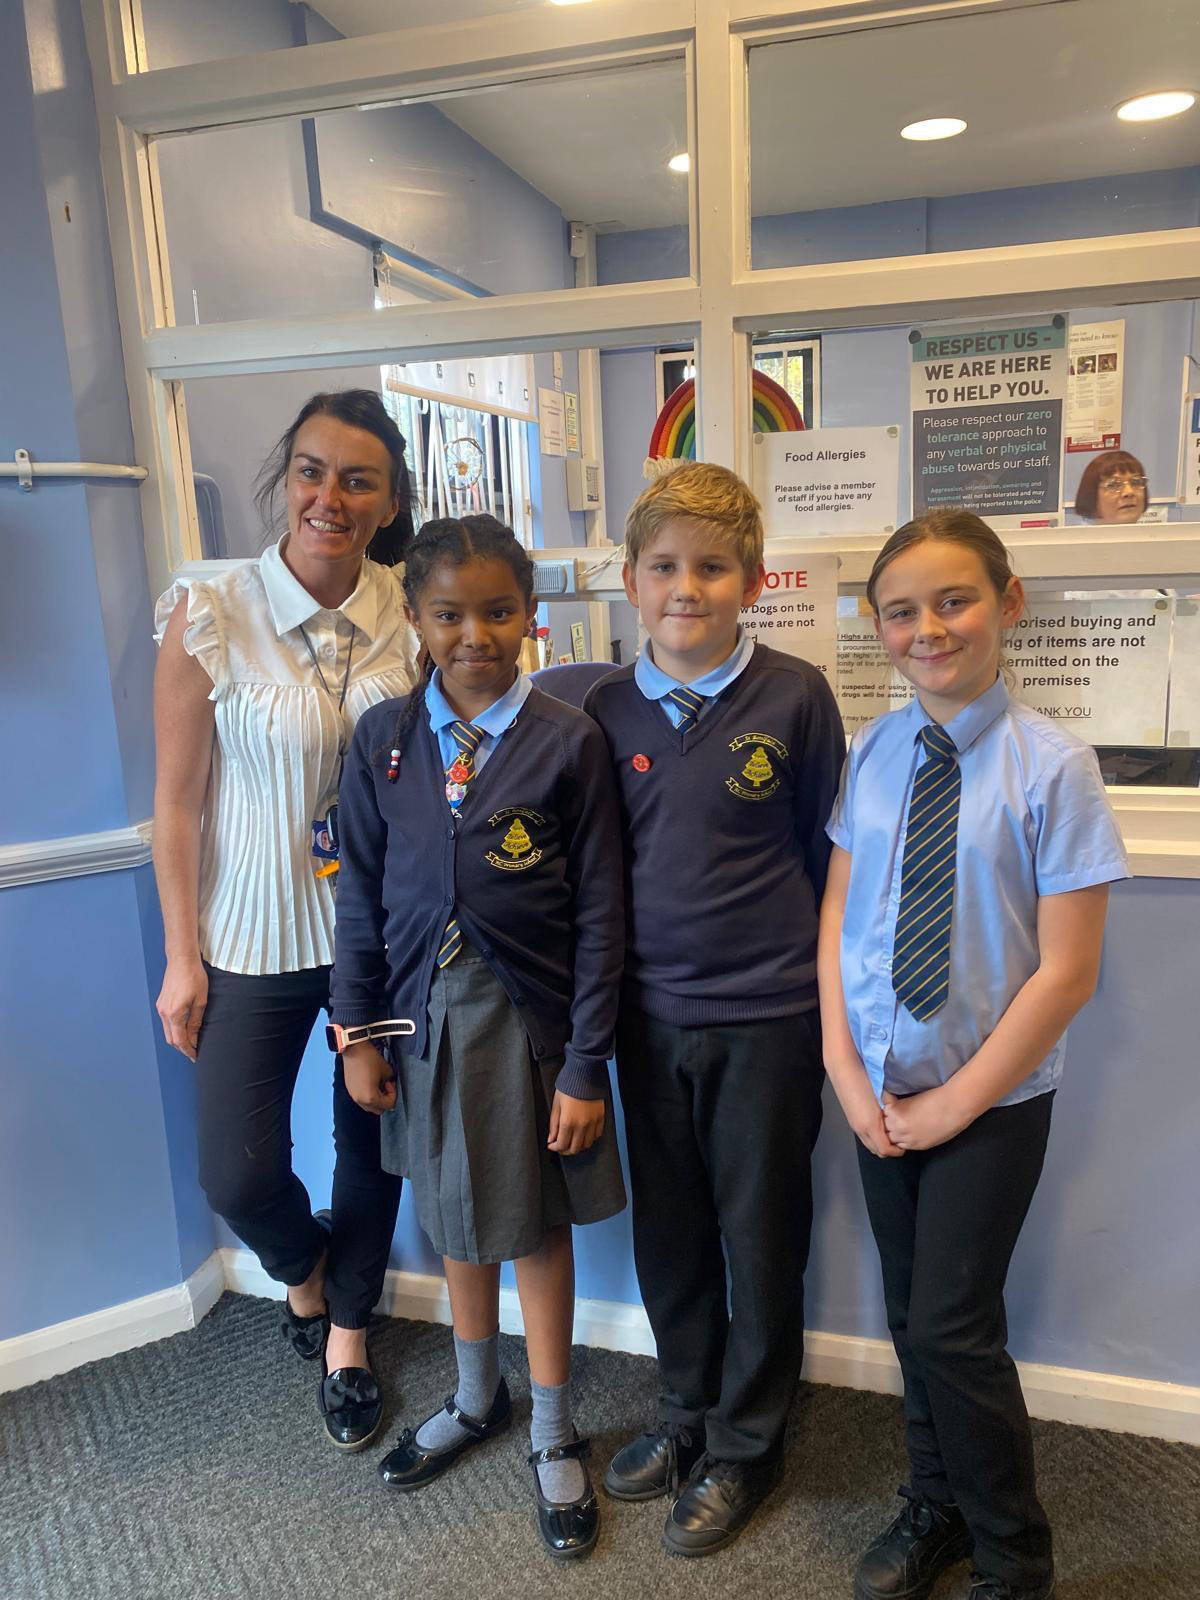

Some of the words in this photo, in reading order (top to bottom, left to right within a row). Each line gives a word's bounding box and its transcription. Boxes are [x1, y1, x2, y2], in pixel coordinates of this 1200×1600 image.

[926, 334, 1009, 357] RESPECT
[1013, 331, 1038, 349] US
[924, 363, 954, 381] WE
[958, 359, 996, 378] ARE
[1001, 354, 1052, 374] HERE
[925, 388, 949, 404] TO
[953, 383, 1002, 402] HELP
[1006, 379, 1049, 397] YOU.
[923, 417, 959, 429] Please
[961, 413, 1002, 427] respect
[1005, 411, 1025, 422] our
[1026, 410, 1052, 421] zero
[927, 431, 979, 444] tolerance
[982, 426, 1033, 442] approach
[1036, 426, 1047, 436] to
[785, 452, 813, 462] Food
[816, 449, 866, 462] Allergies
[926, 450, 946, 461] any
[947, 445, 984, 457] verbal
[986, 446, 998, 455] or
[1000, 440, 1046, 456] physical
[922, 464, 955, 475] abuse
[957, 460, 1001, 472] towards
[1003, 460, 1022, 469] our
[1024, 456, 1051, 468] staff.
[774, 484, 802, 493] Please
[804, 483, 832, 491] advise
[841, 481, 876, 490] member
[777, 495, 787, 503] of
[788, 494, 807, 502] staff
[808, 493, 815, 501] if
[816, 494, 832, 503] you
[834, 492, 854, 500] have
[856, 492, 872, 501] any
[992, 490, 1019, 498] tolerated
[794, 504, 814, 512] food
[815, 503, 854, 512] allergies.
[980, 500, 1005, 508] reported
[764, 570, 808, 589] OTE
[751, 604, 778, 615] Dogs
[780, 605, 794, 613] on
[797, 602, 815, 612] the
[776, 620, 794, 628] are
[796, 619, 815, 627] not
[1070, 615, 1122, 630] buying
[1127, 615, 1157, 627] and
[840, 633, 861, 641] Highs
[1027, 635, 1043, 648] of
[1046, 635, 1087, 648] items
[1092, 637, 1116, 648] are
[1120, 635, 1146, 647] not
[1007, 655, 1068, 668] ermitted
[1072, 657, 1091, 667] on
[1095, 655, 1120, 667] the
[1022, 674, 1091, 688] premises
[1033, 706, 1061, 717] ANK
[1064, 706, 1092, 717] YOU
